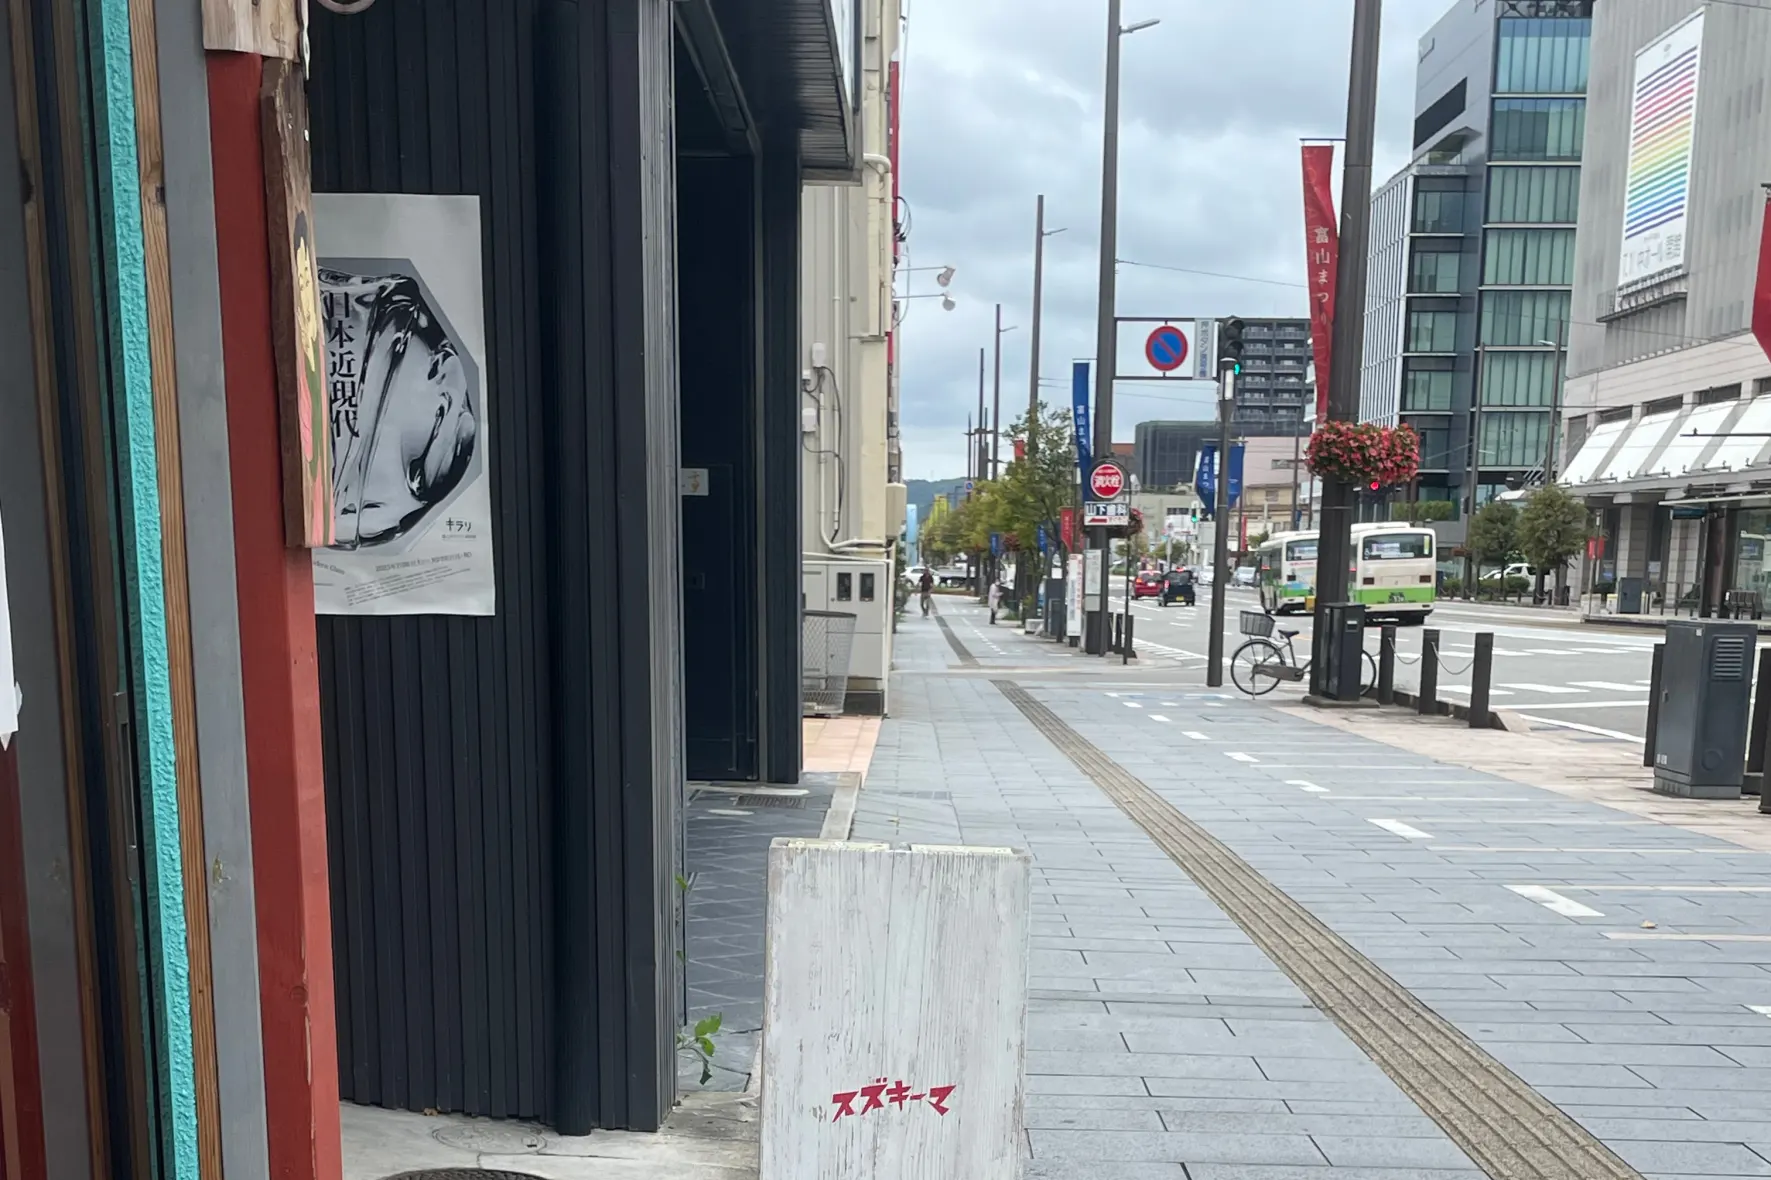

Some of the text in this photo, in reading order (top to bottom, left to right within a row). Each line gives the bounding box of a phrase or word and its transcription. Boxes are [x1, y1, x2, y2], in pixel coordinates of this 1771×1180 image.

[328, 291, 360, 438] 日本近現代
[445, 517, 472, 532] キラリ
[832, 1077, 957, 1123] スズキーマ
